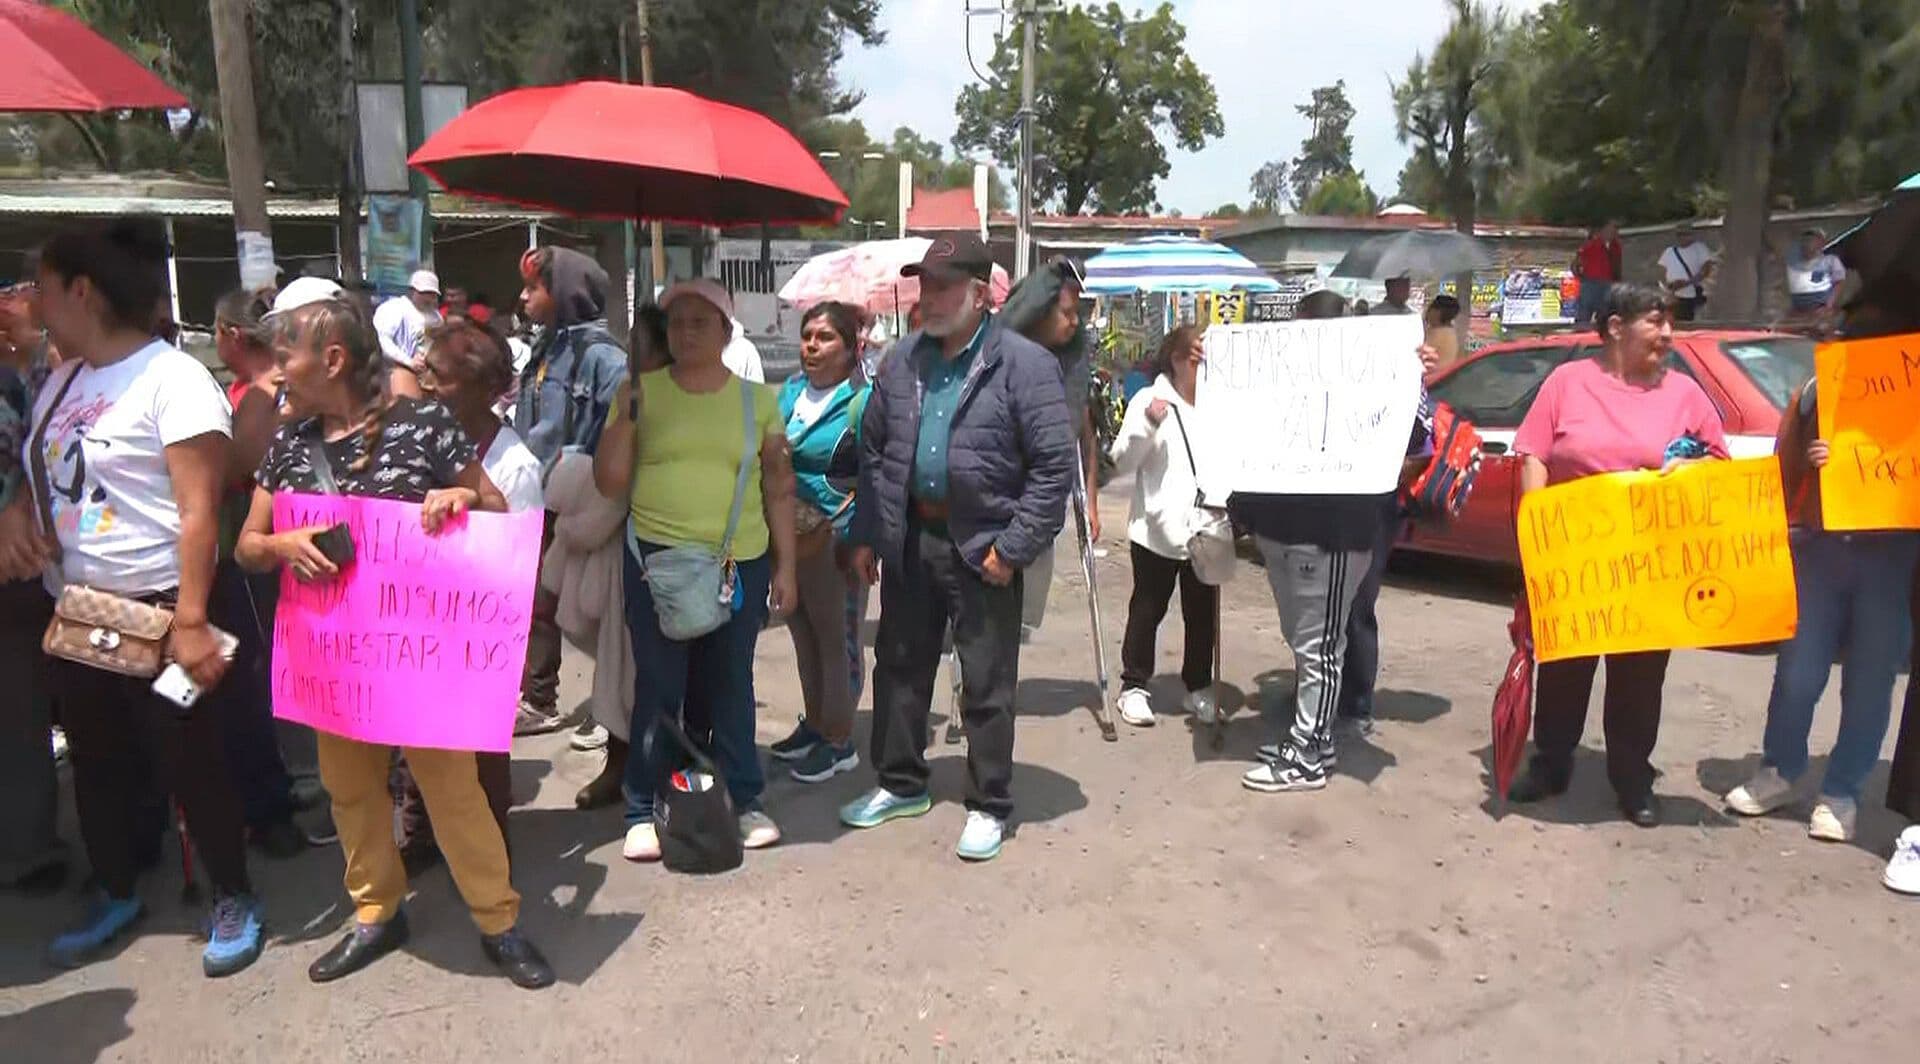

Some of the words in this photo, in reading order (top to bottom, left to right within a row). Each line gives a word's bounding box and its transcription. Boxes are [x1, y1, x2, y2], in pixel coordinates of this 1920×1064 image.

[1833, 361, 1896, 401] Sin
[1528, 498, 1617, 554] IMSS
[1530, 569, 1569, 610] NO
